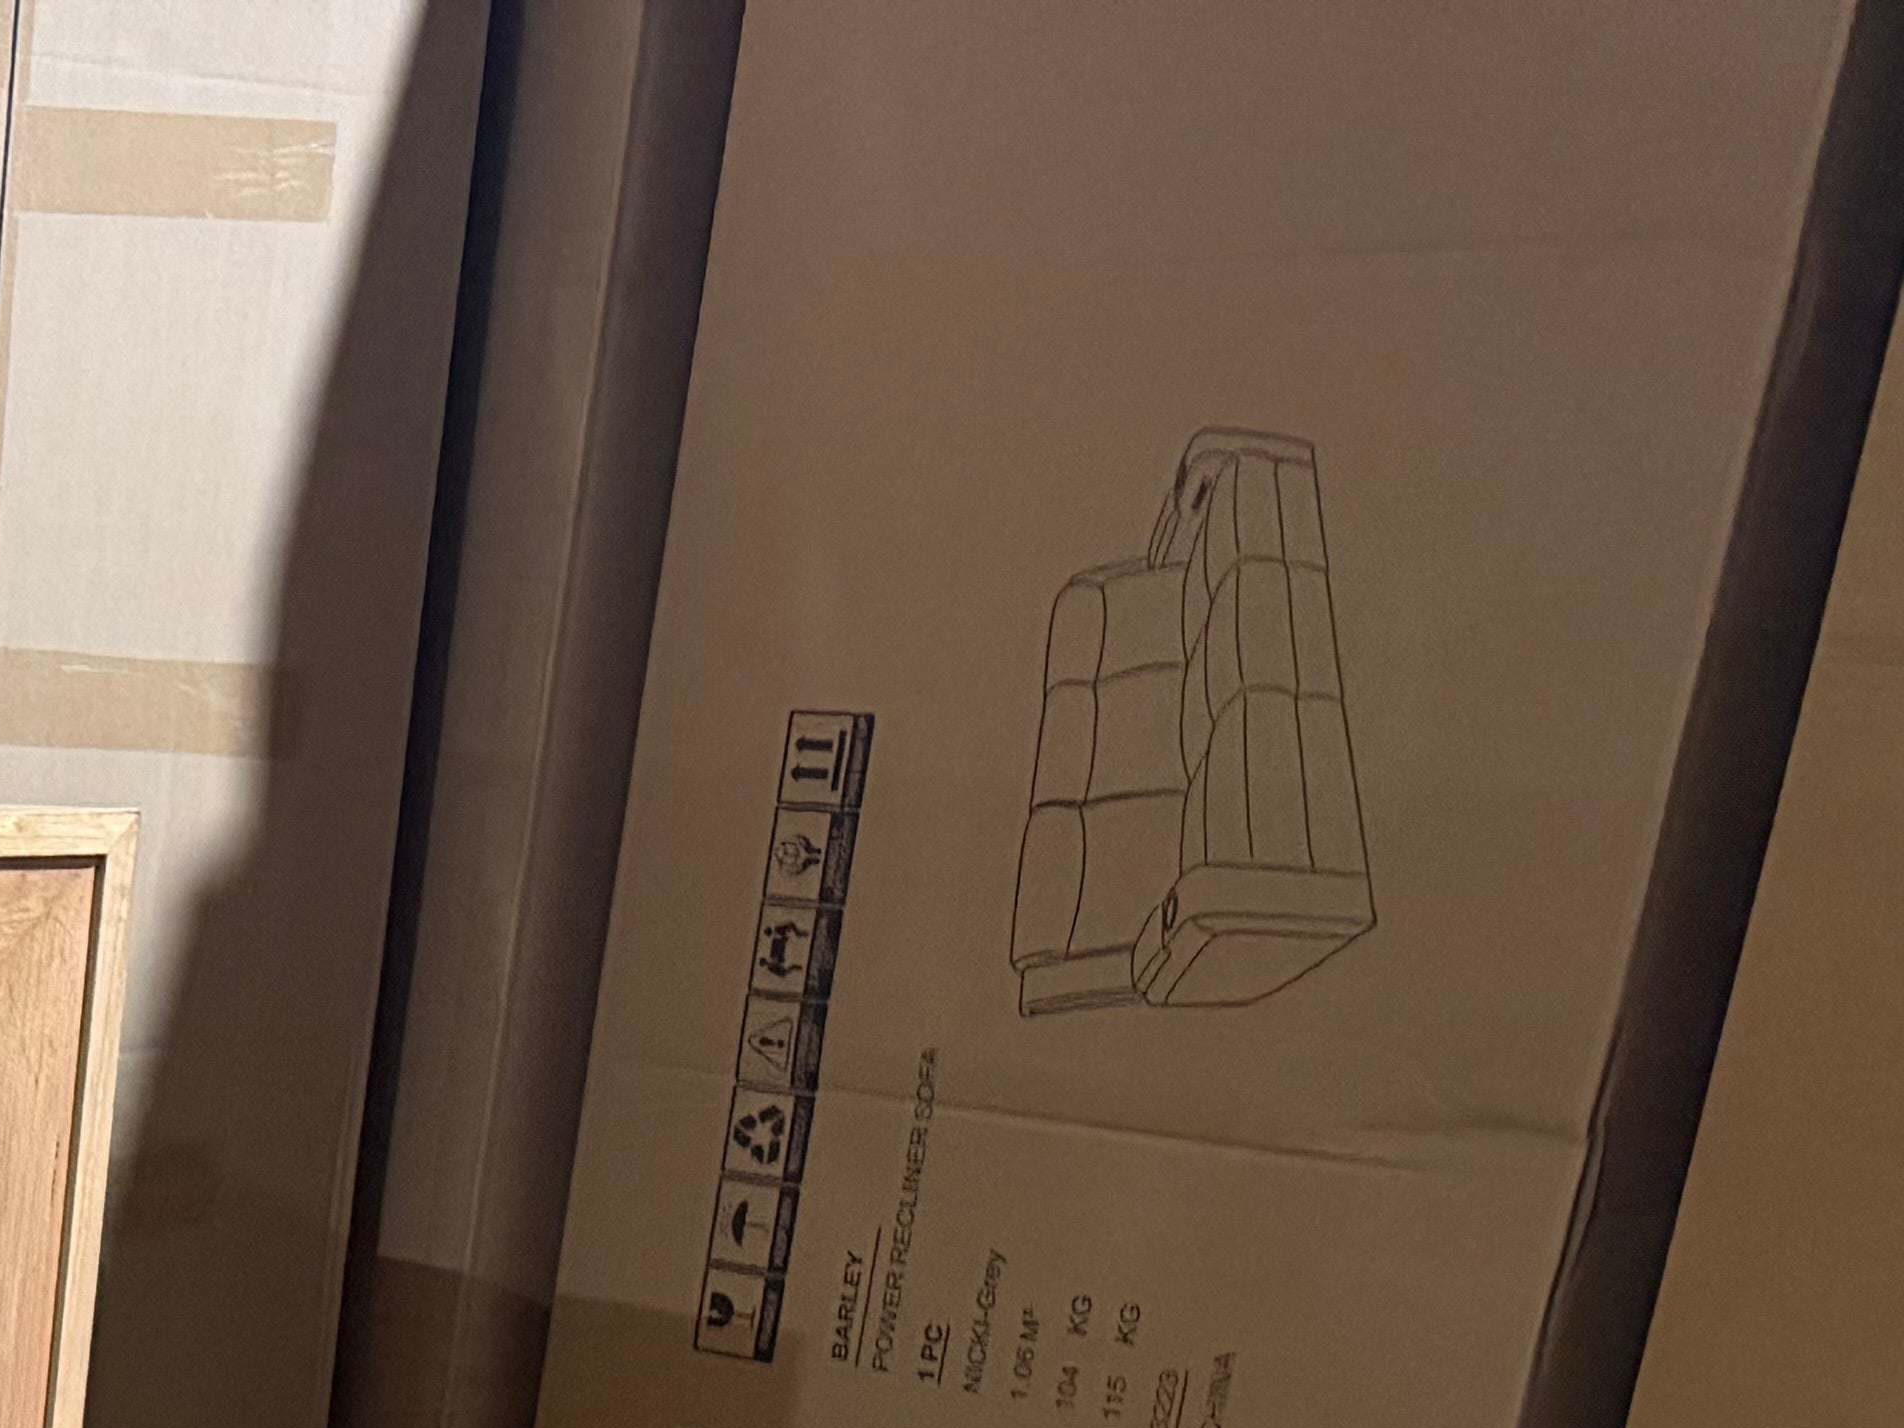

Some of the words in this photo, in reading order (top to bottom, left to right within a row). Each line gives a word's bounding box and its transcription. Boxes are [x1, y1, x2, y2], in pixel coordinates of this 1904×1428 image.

[873, 1270, 903, 1372] POWER
[890, 1125, 929, 1267] RECLINER
[914, 1047, 937, 1122] SOFA
[832, 1250, 862, 1361] BARLEY
[1067, 1294, 1092, 1337] KG
[1115, 1302, 1141, 1346] KG
[921, 1321, 944, 1362] PC
[917, 1367, 936, 1383] 1
